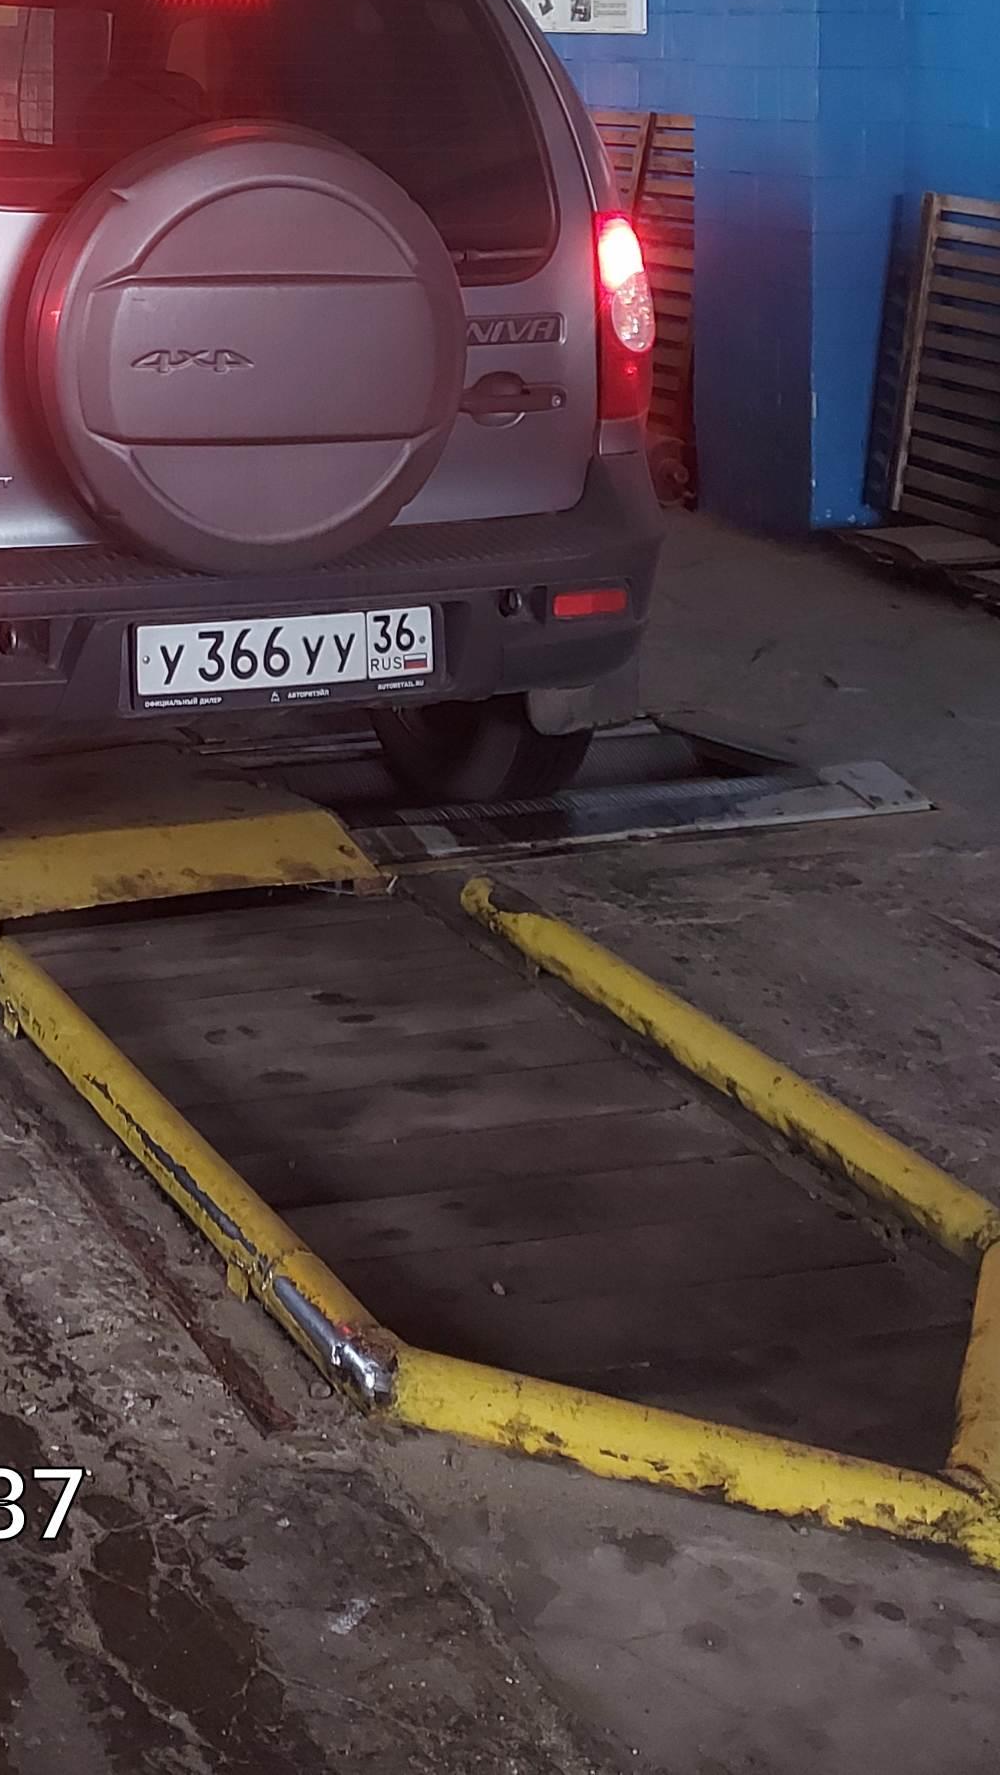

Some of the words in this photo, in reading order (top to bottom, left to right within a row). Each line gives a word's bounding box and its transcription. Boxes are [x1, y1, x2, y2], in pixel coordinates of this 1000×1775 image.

[466, 318, 557, 343] NIVA
[373, 613, 415, 654] 36
[370, 654, 402, 673] RUS
[144, 697, 198, 708] ОФИЦИАЛЬНЫЙ
[199, 696, 222, 705] ДИЛЕР
